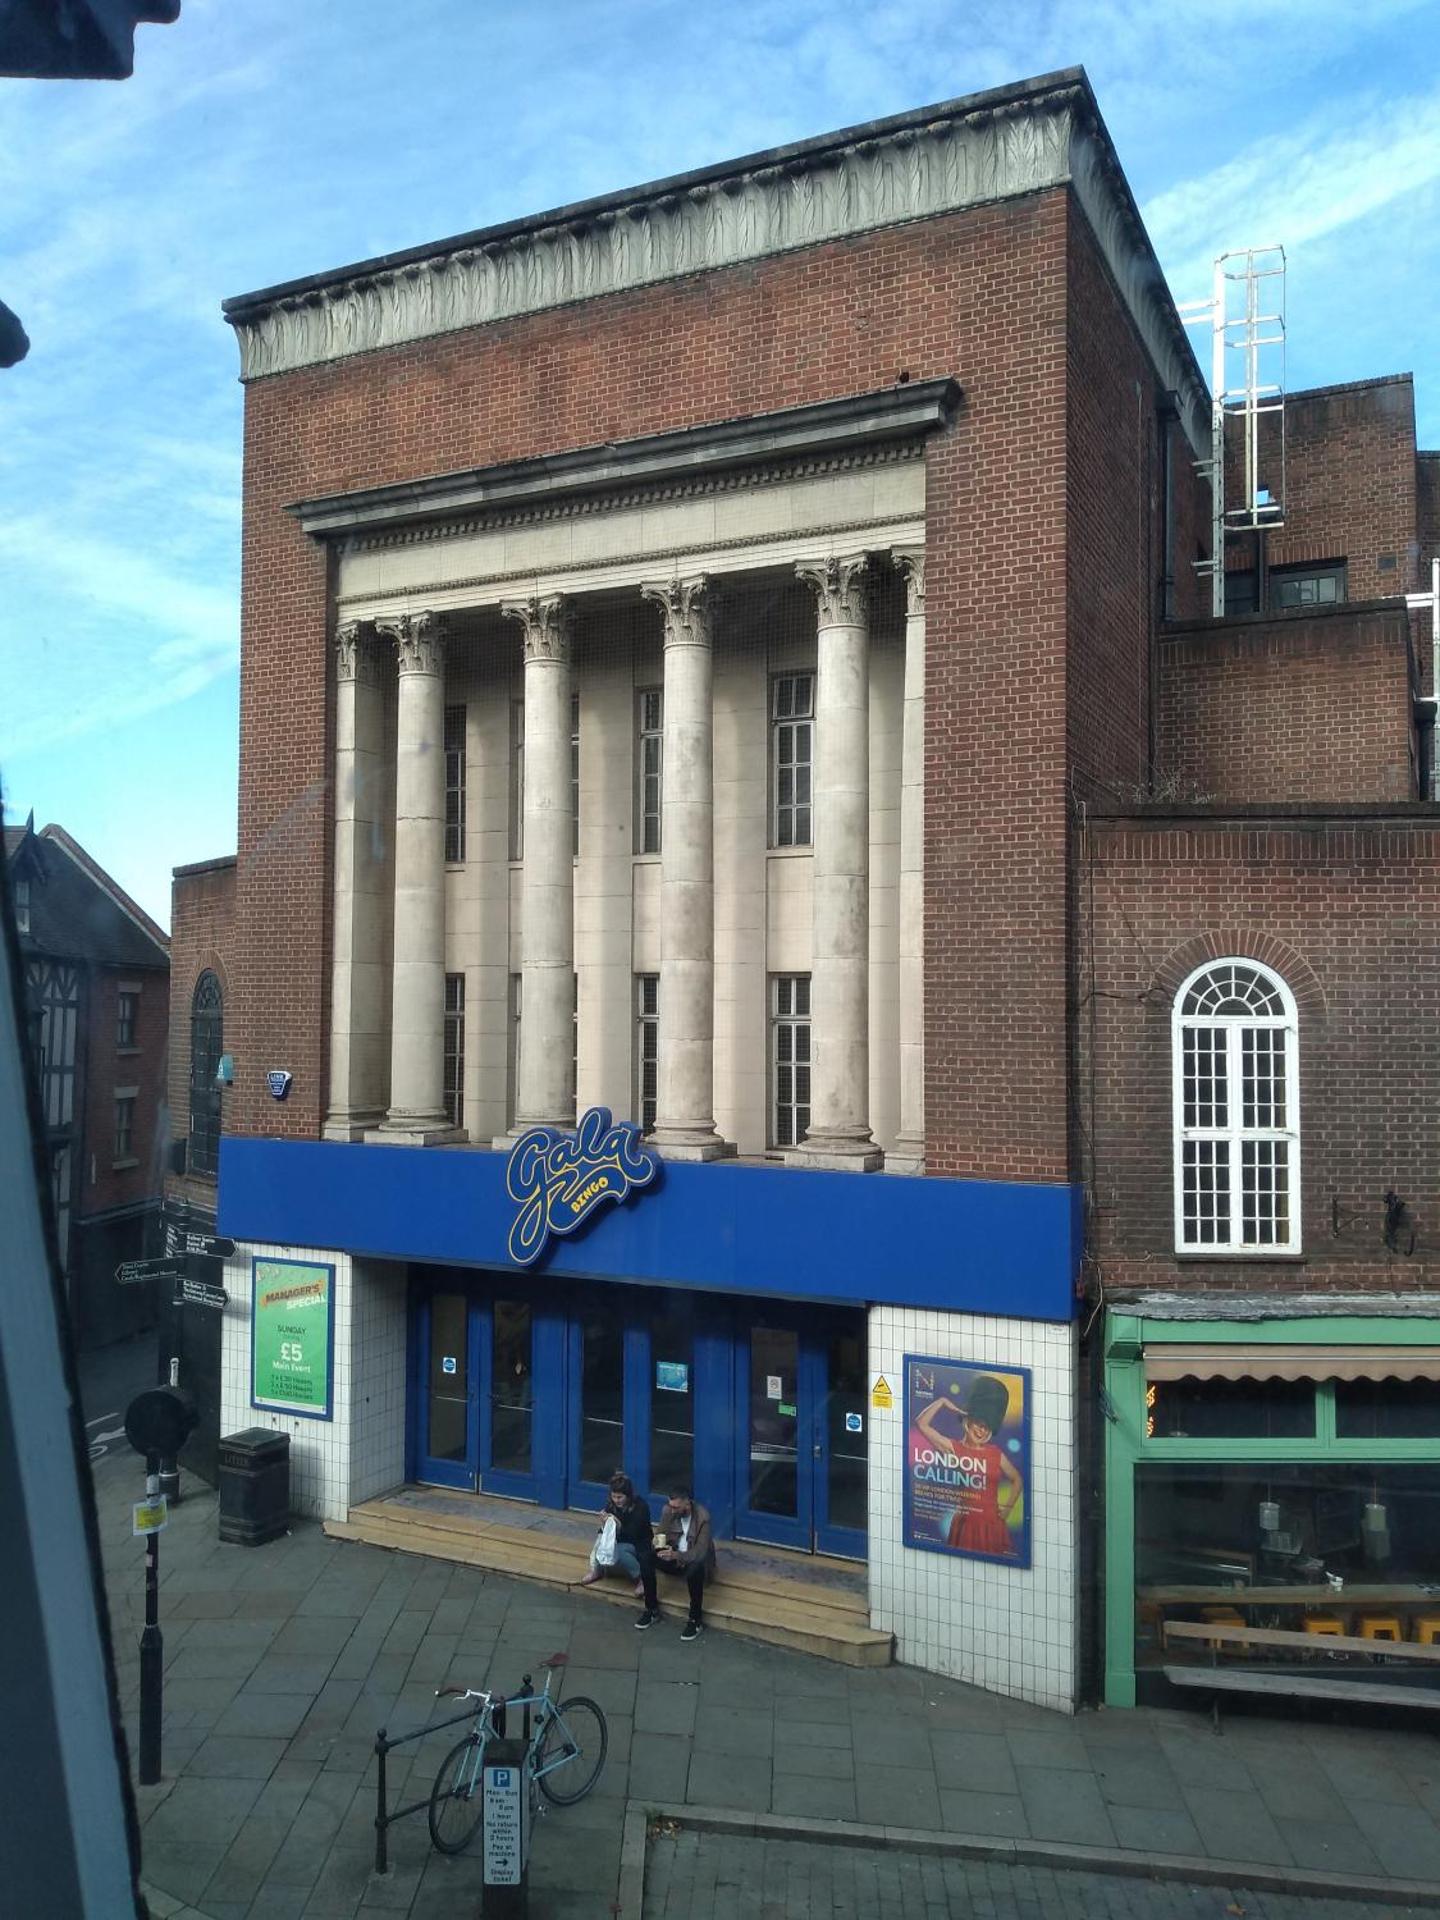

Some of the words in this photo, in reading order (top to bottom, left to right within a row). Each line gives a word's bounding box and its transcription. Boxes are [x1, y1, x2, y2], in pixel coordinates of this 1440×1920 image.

[507, 1109, 654, 1264] Gala
[571, 1176, 609, 1213] BINGO
[265, 1284, 320, 1303] MANAGER'S
[286, 1294, 325, 1310] SPECIAL
[277, 1325, 306, 1334] SUNDAY
[280, 1342, 303, 1362] £5
[272, 1360, 291, 1371] Main
[291, 1363, 311, 1374] Event
[914, 1447, 987, 1474] LONDON
[913, 1464, 987, 1490] CALLING!
[497, 1771, 508, 1785] P
